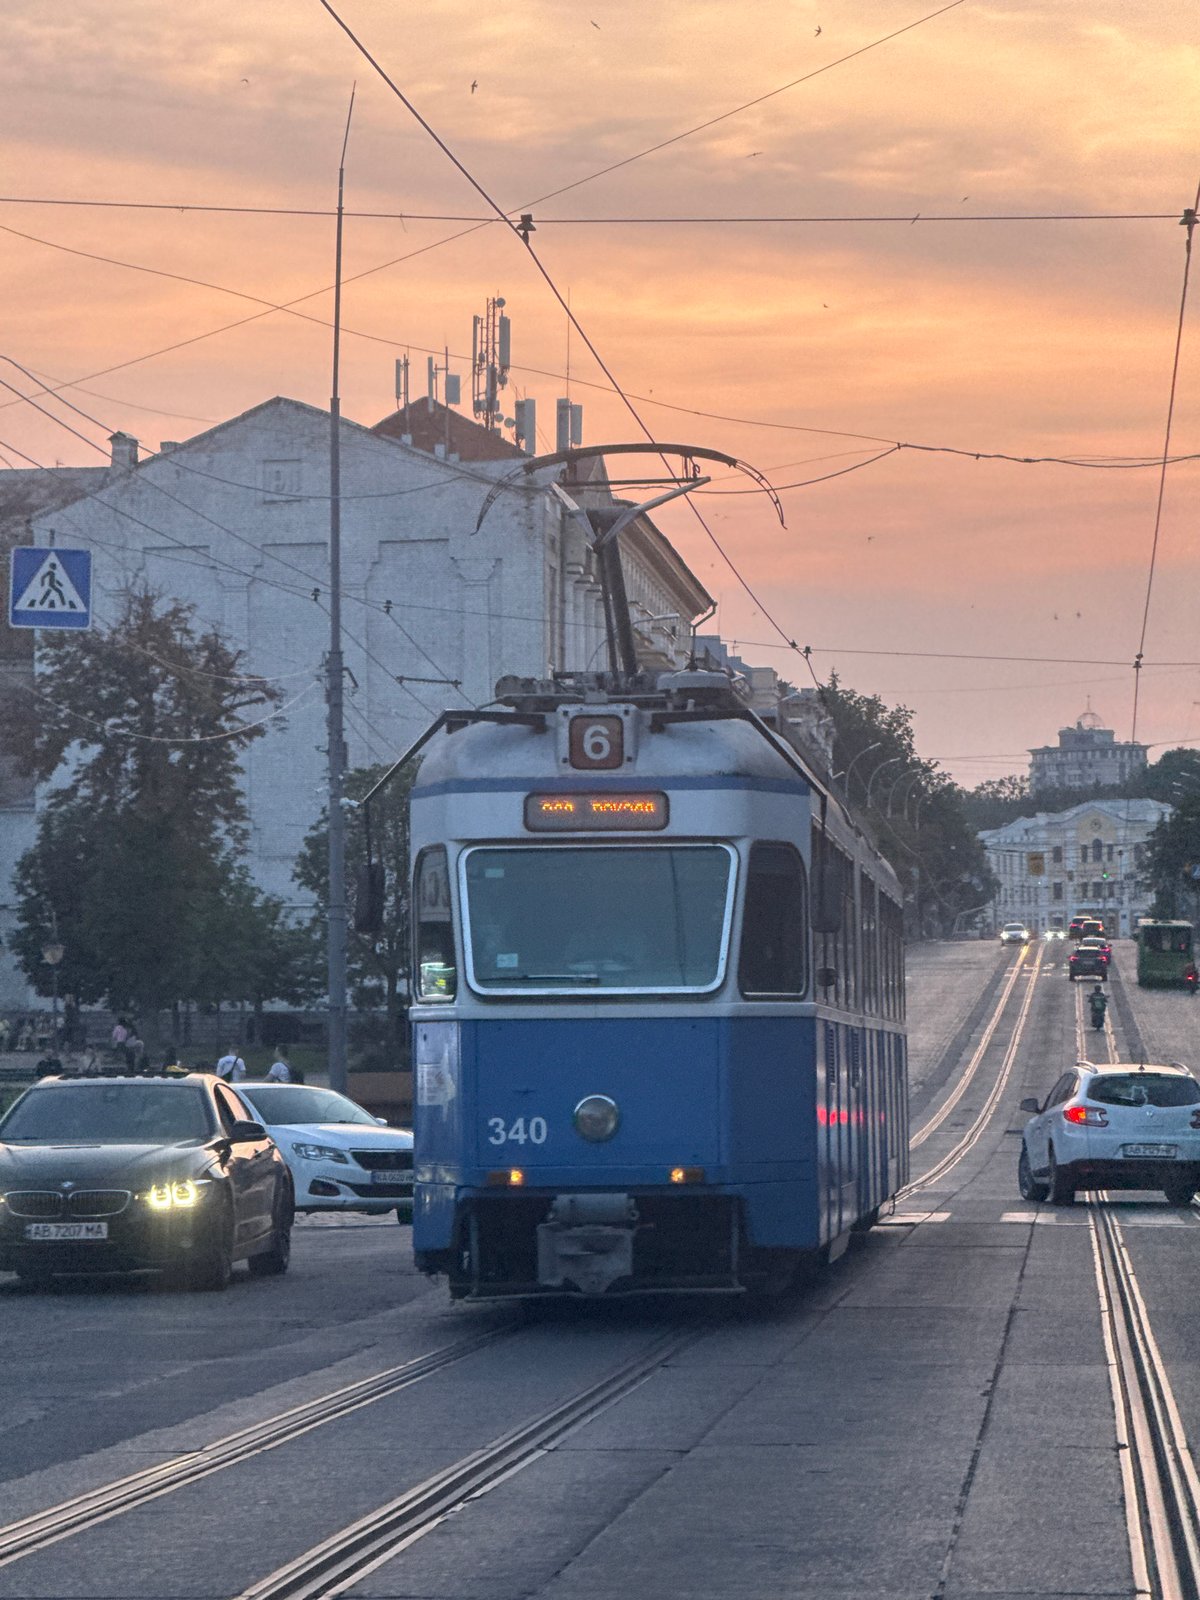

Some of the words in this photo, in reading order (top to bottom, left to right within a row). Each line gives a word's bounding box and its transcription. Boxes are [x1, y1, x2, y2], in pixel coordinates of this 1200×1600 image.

[583, 724, 611, 760] 6
[488, 1117, 547, 1145] 340
[54, 1225, 83, 1237] 7207
